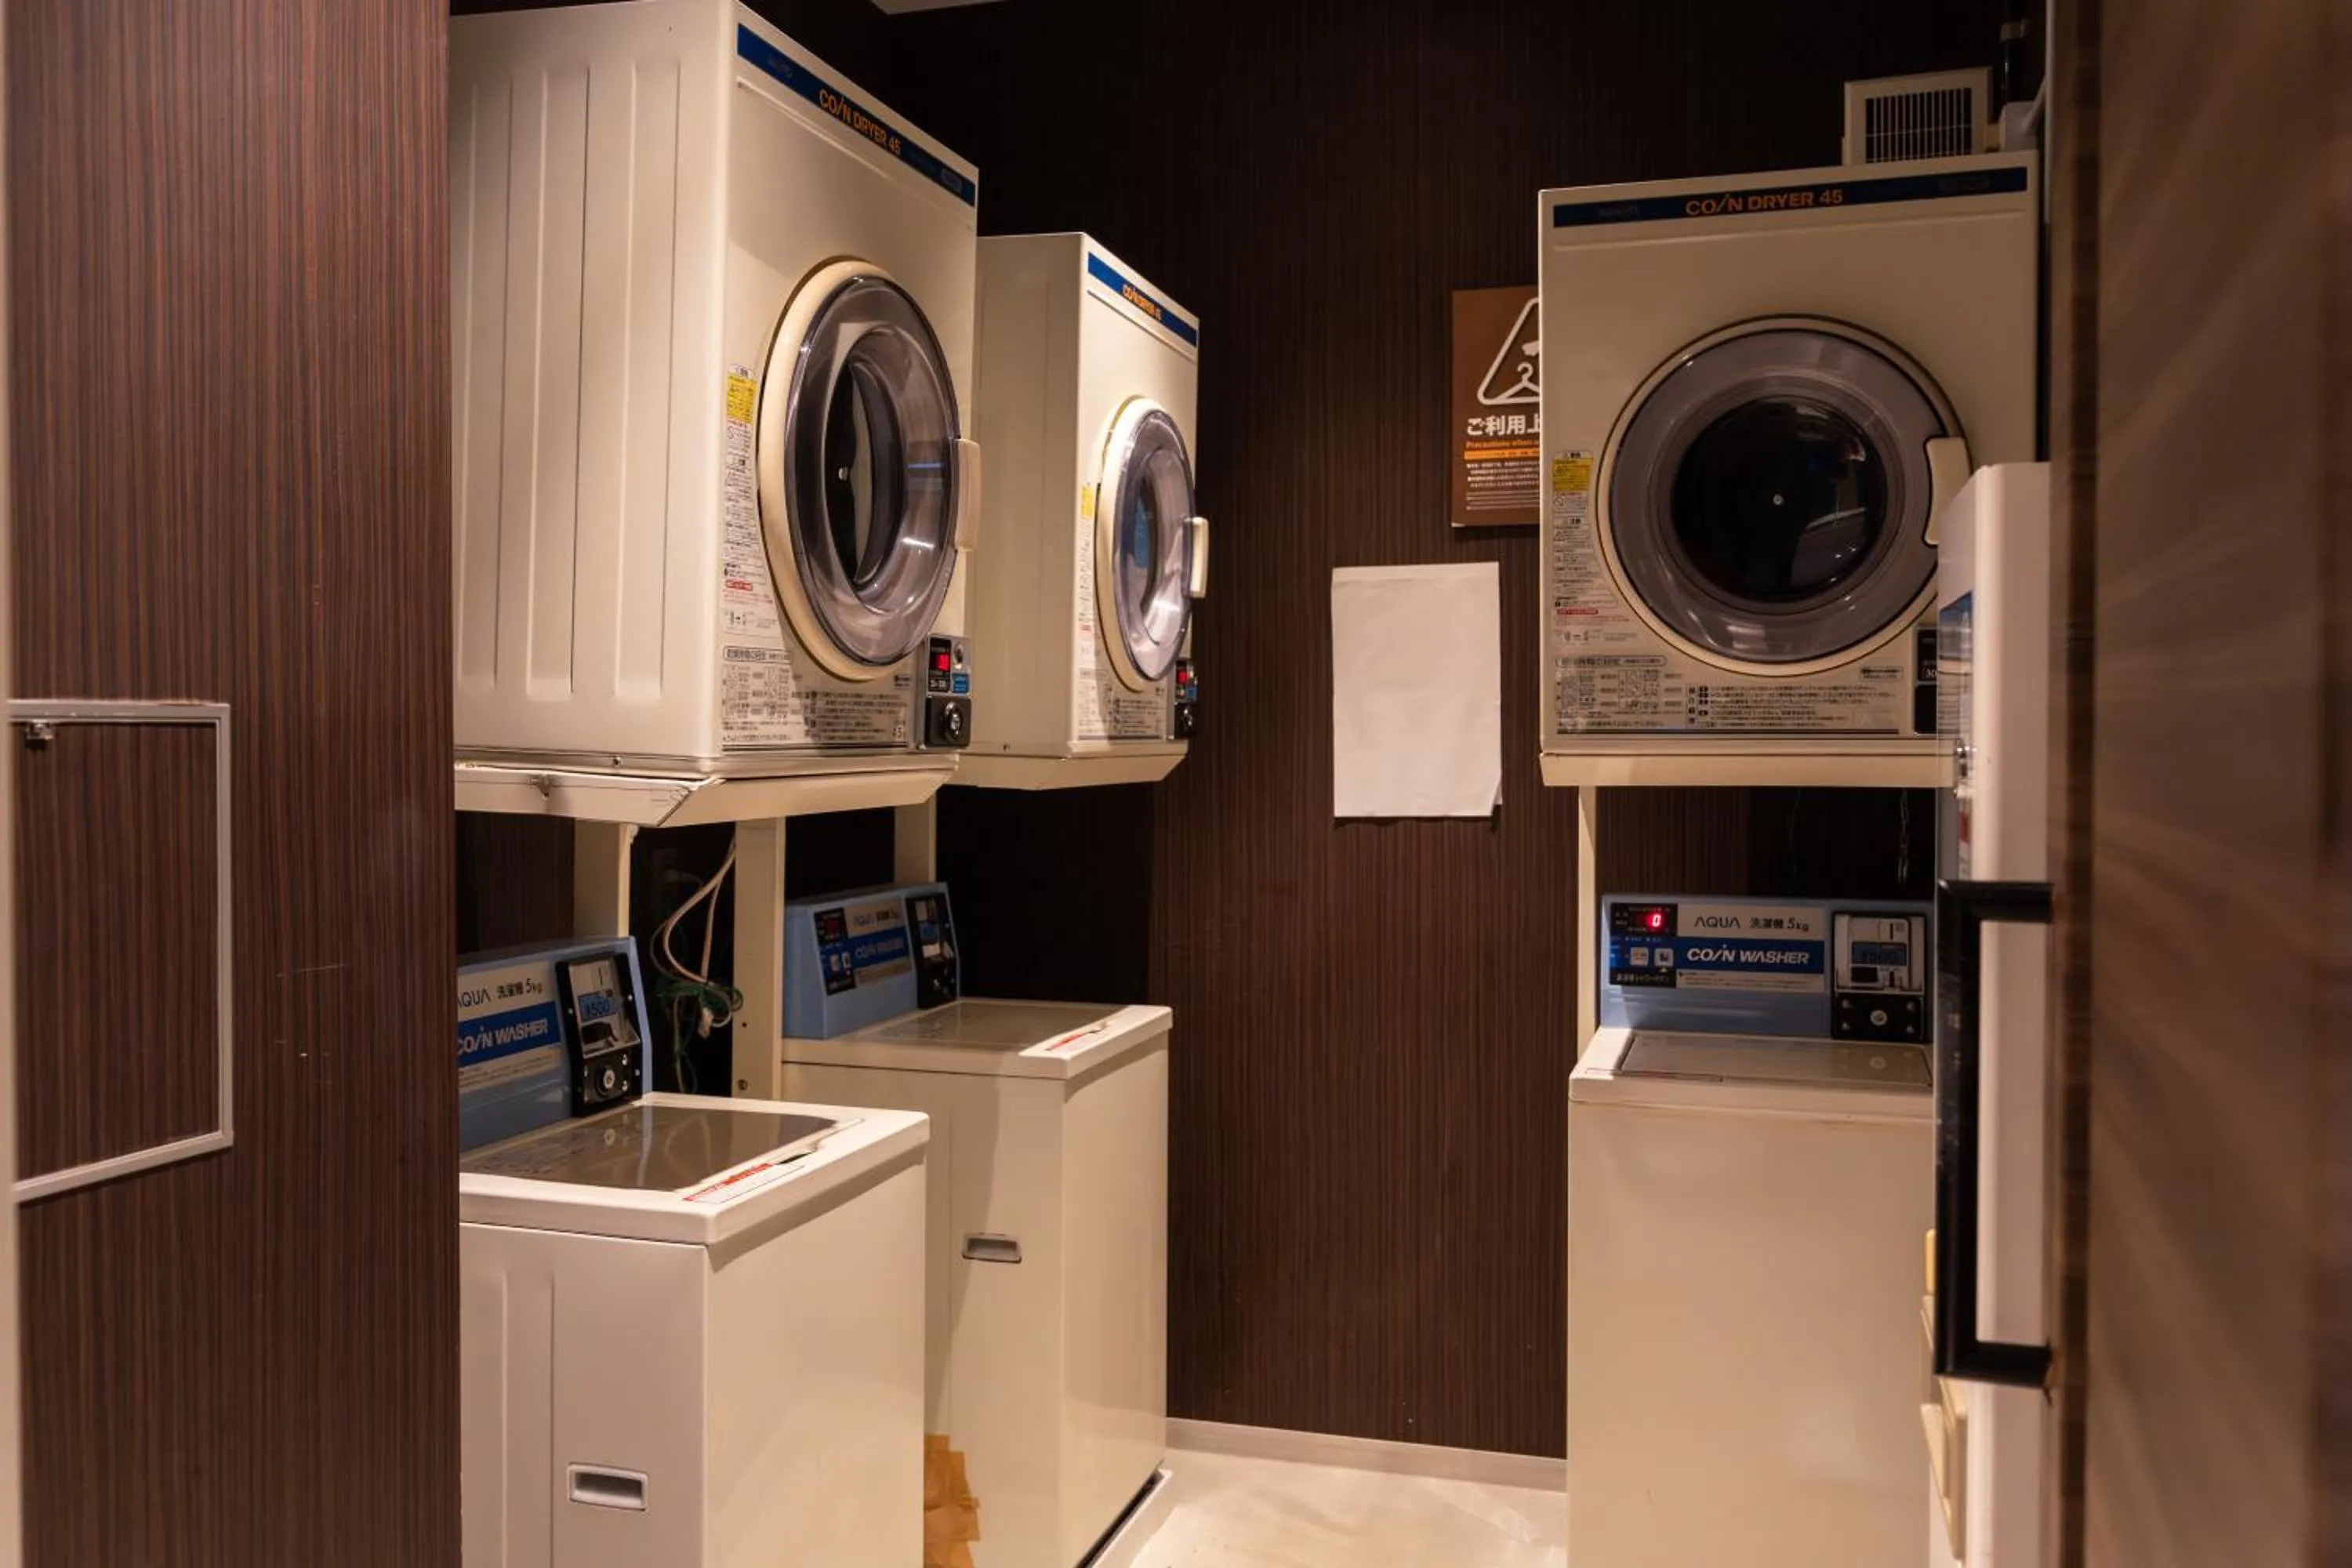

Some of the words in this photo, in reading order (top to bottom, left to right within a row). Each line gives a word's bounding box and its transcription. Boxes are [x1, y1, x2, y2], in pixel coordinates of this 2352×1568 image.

[853, 110, 887, 145] DRYER
[888, 136, 902, 155] 45
[1748, 191, 1814, 212] DRYER
[1820, 189, 1843, 206] 45
[1693, 915, 1740, 930] AQUA
[1787, 916, 1810, 933] 5kg
[1740, 951, 1810, 965] WASHER
[495, 1018, 549, 1046] WASHER
